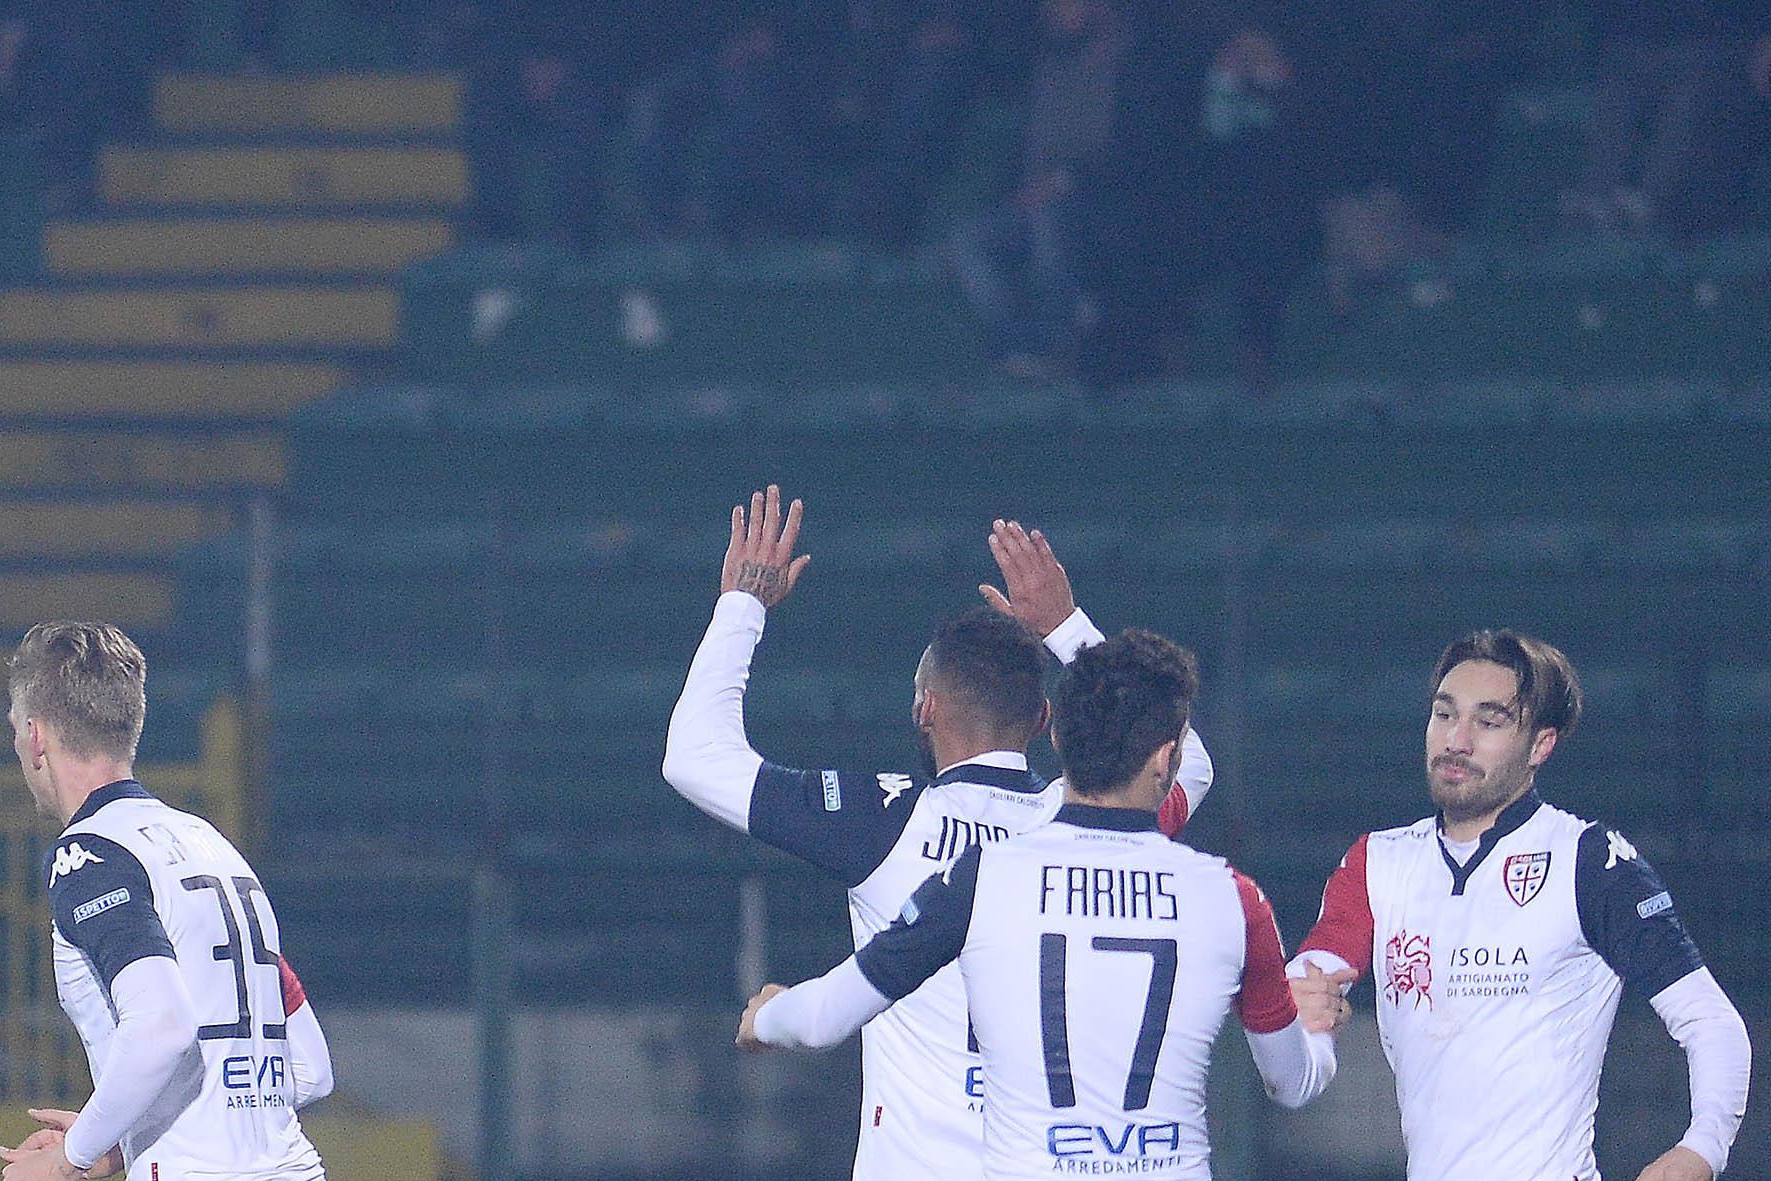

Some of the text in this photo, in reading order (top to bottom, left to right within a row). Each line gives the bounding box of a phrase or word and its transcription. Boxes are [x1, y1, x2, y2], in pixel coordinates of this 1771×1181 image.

[1040, 865, 1179, 920] FARIAS
[181, 875, 288, 1041] 35
[1450, 947, 1528, 967] ISOLA
[1447, 985, 1528, 998] DI SARDEGNA
[1448, 973, 1529, 984] ARTIGIANATO
[1039, 932, 1179, 1111] 17
[223, 1055, 285, 1089] EVA
[1047, 1122, 1179, 1157] EVA
[1052, 1154, 1181, 1175] ARREDAMENTI
